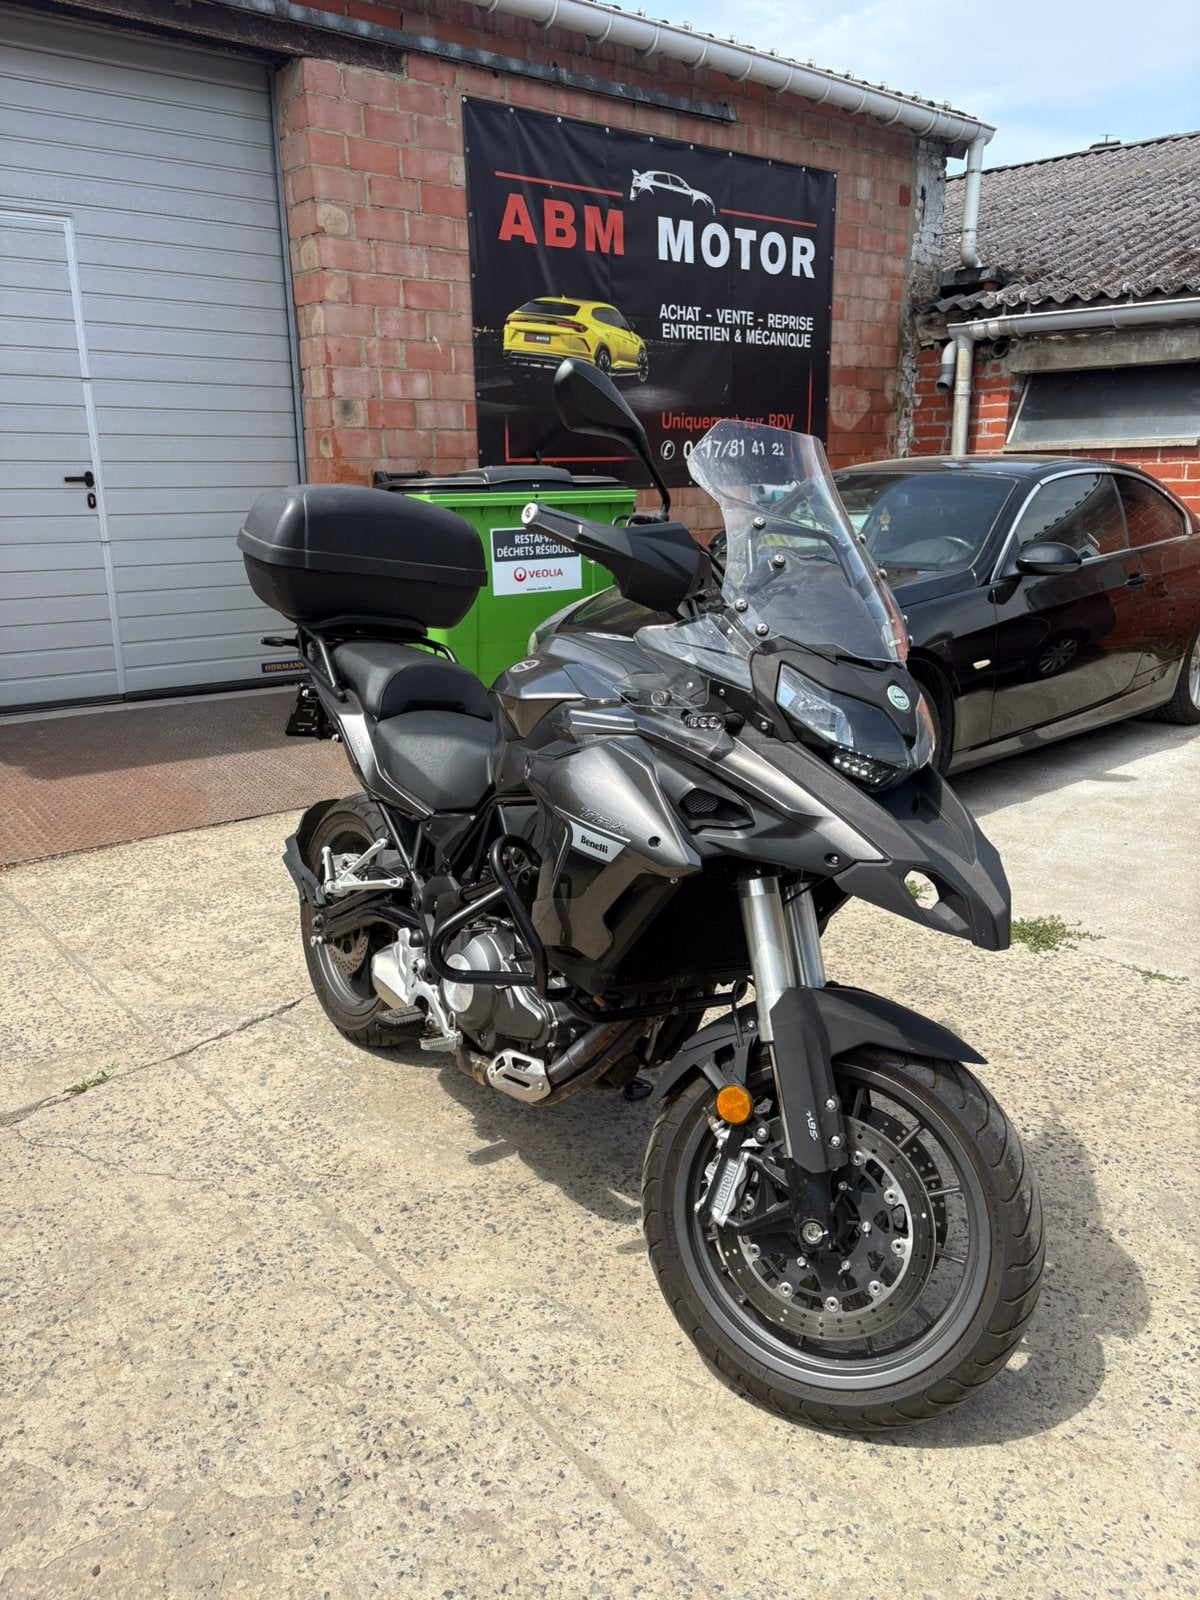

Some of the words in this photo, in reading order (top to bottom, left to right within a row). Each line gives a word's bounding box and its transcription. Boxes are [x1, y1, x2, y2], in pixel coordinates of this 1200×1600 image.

[498, 192, 625, 256] ABM
[657, 215, 816, 279] MOTOR
[659, 303, 702, 322] ACHAT
[716, 308, 755, 326] VENTE
[767, 313, 814, 331] REPRISE
[662, 322, 730, 342] ENTRETIEN
[734, 329, 742, 343] &
[745, 326, 812, 348] MÉCANIQUE
[661, 411, 740, 432] Uniquemt
[768, 413, 795, 430] RDV
[751, 440, 765, 456] 41
[497, 545, 534, 558] DÉCHETS
[528, 568, 564, 579] VEOLIA
[581, 807, 628, 835] TRK
[580, 835, 609, 854] Benelli
